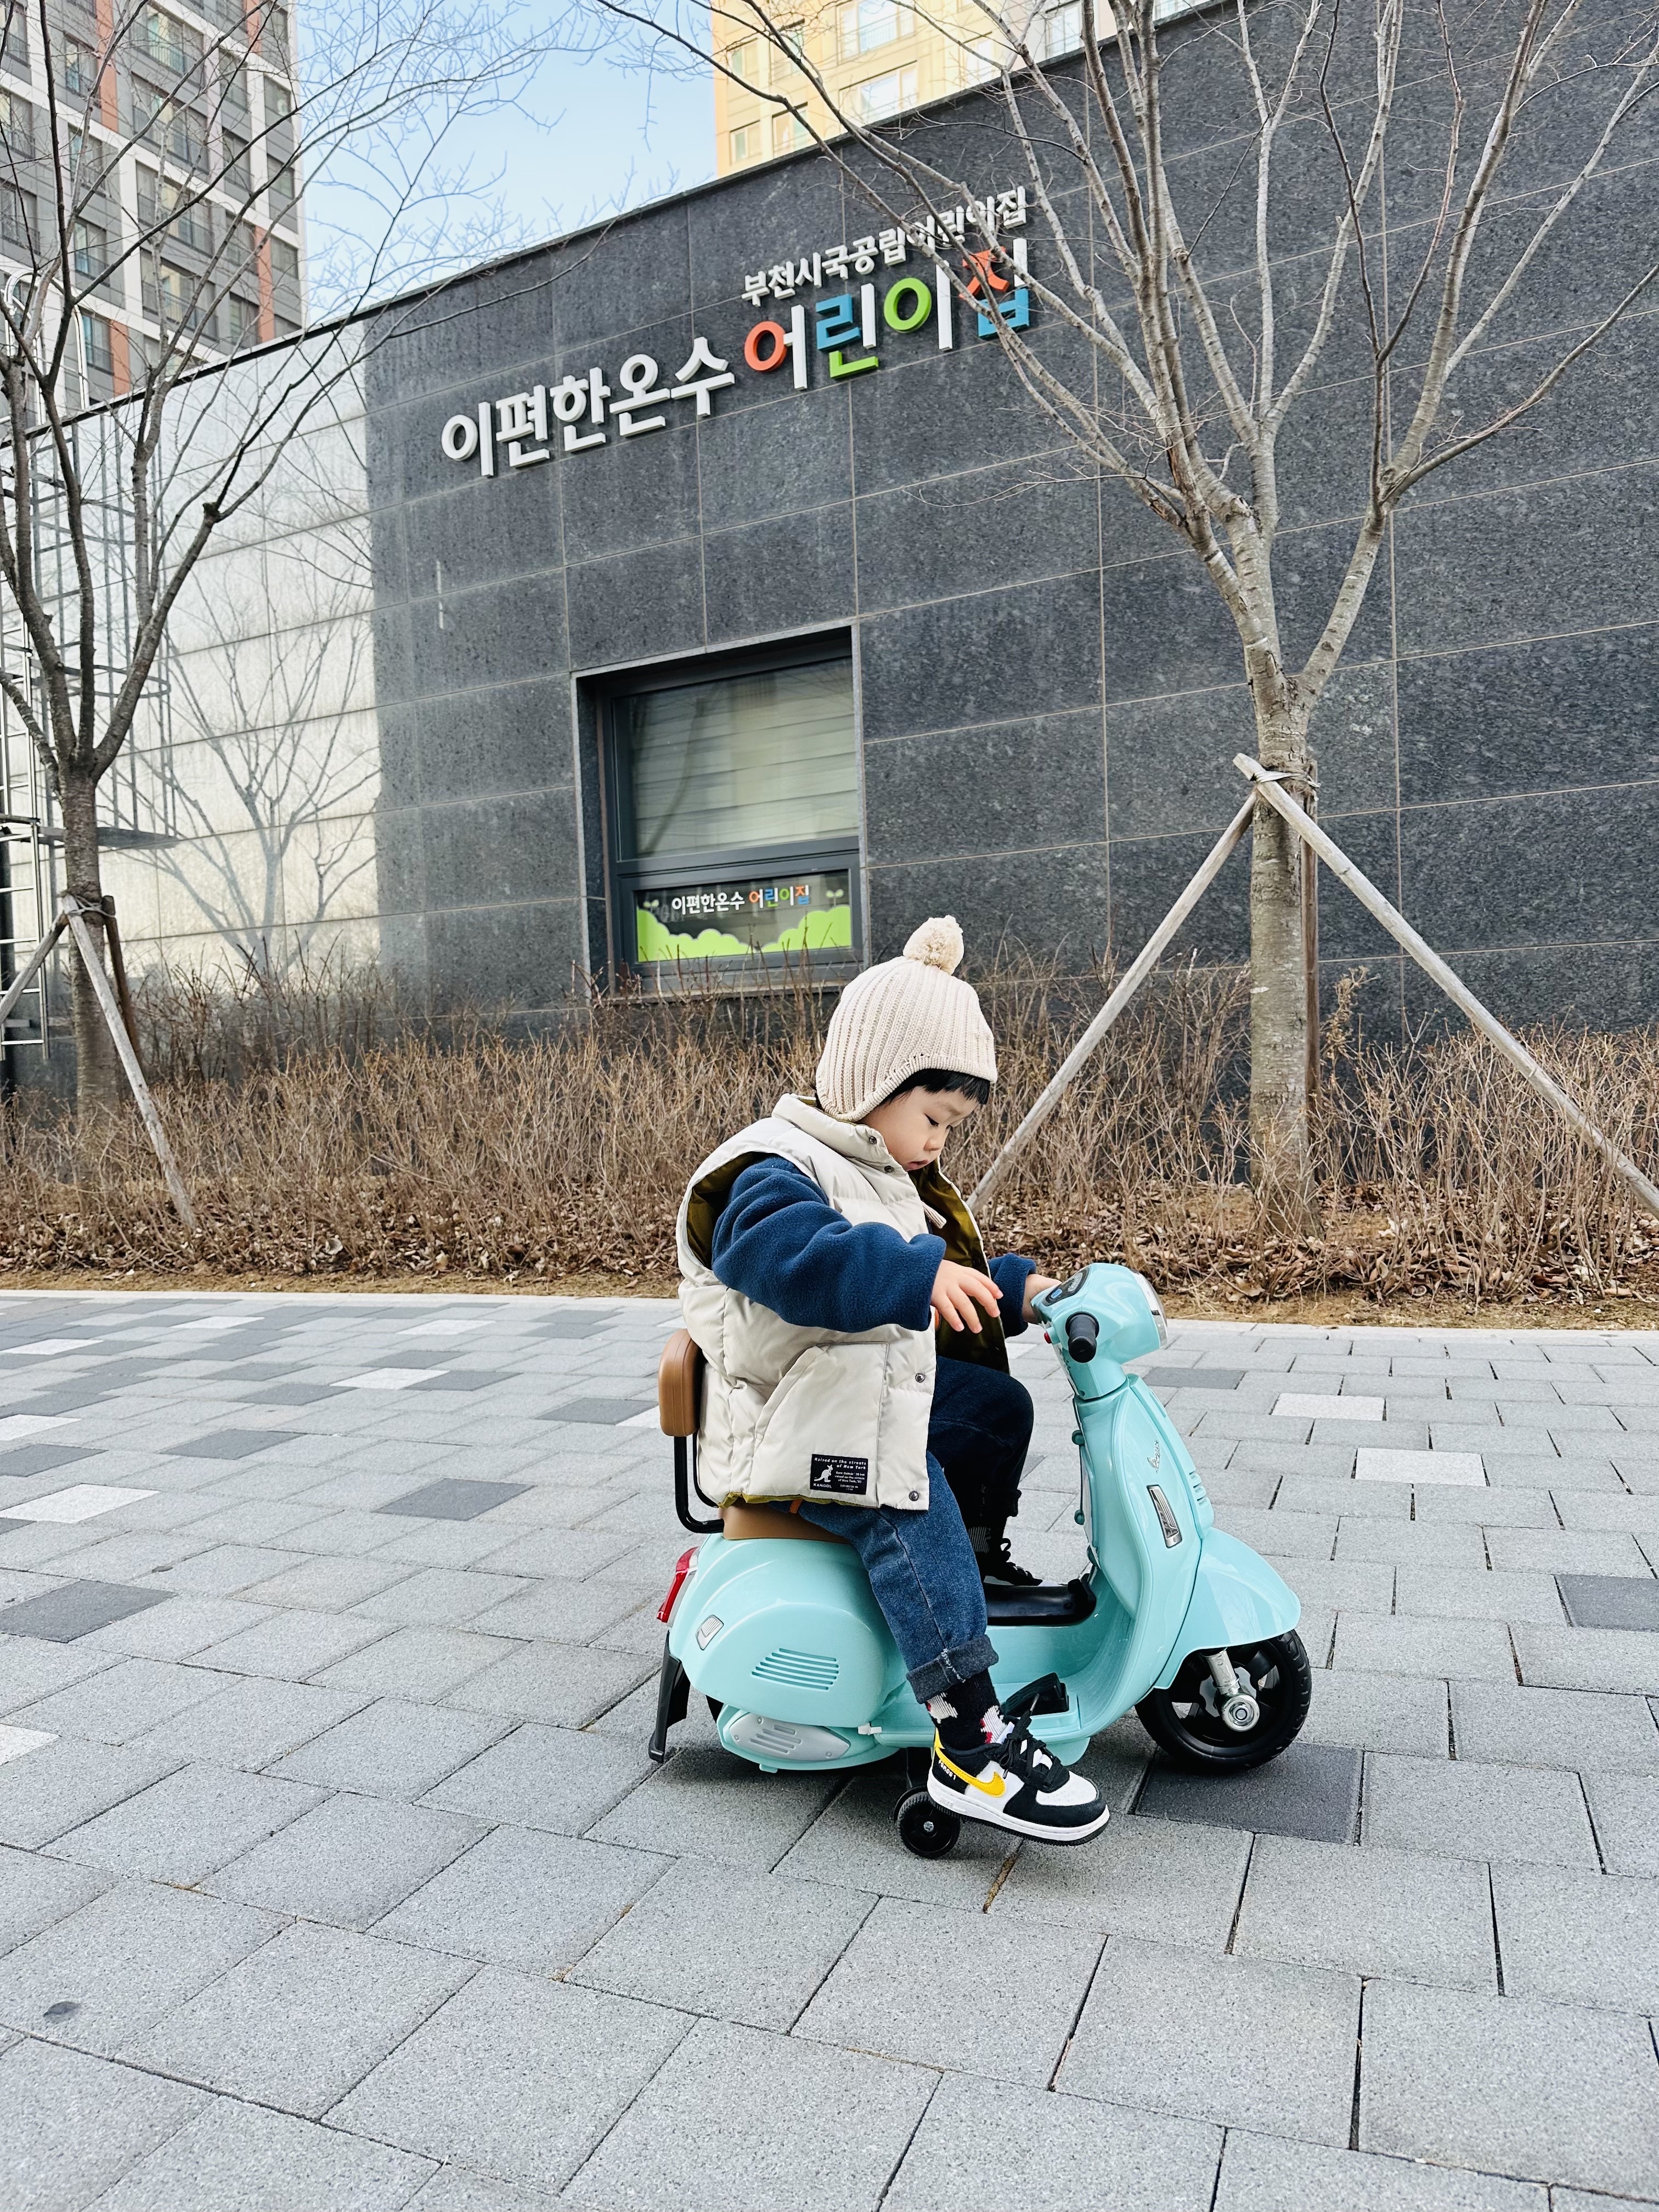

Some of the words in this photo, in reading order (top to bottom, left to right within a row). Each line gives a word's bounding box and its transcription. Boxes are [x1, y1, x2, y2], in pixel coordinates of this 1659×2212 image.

[441, 336, 736, 478] 이편한온수
[744, 238, 1030, 390] 어린이집
[672, 891, 746, 915] 이편한온수
[748, 884, 810, 909] 어린이집
